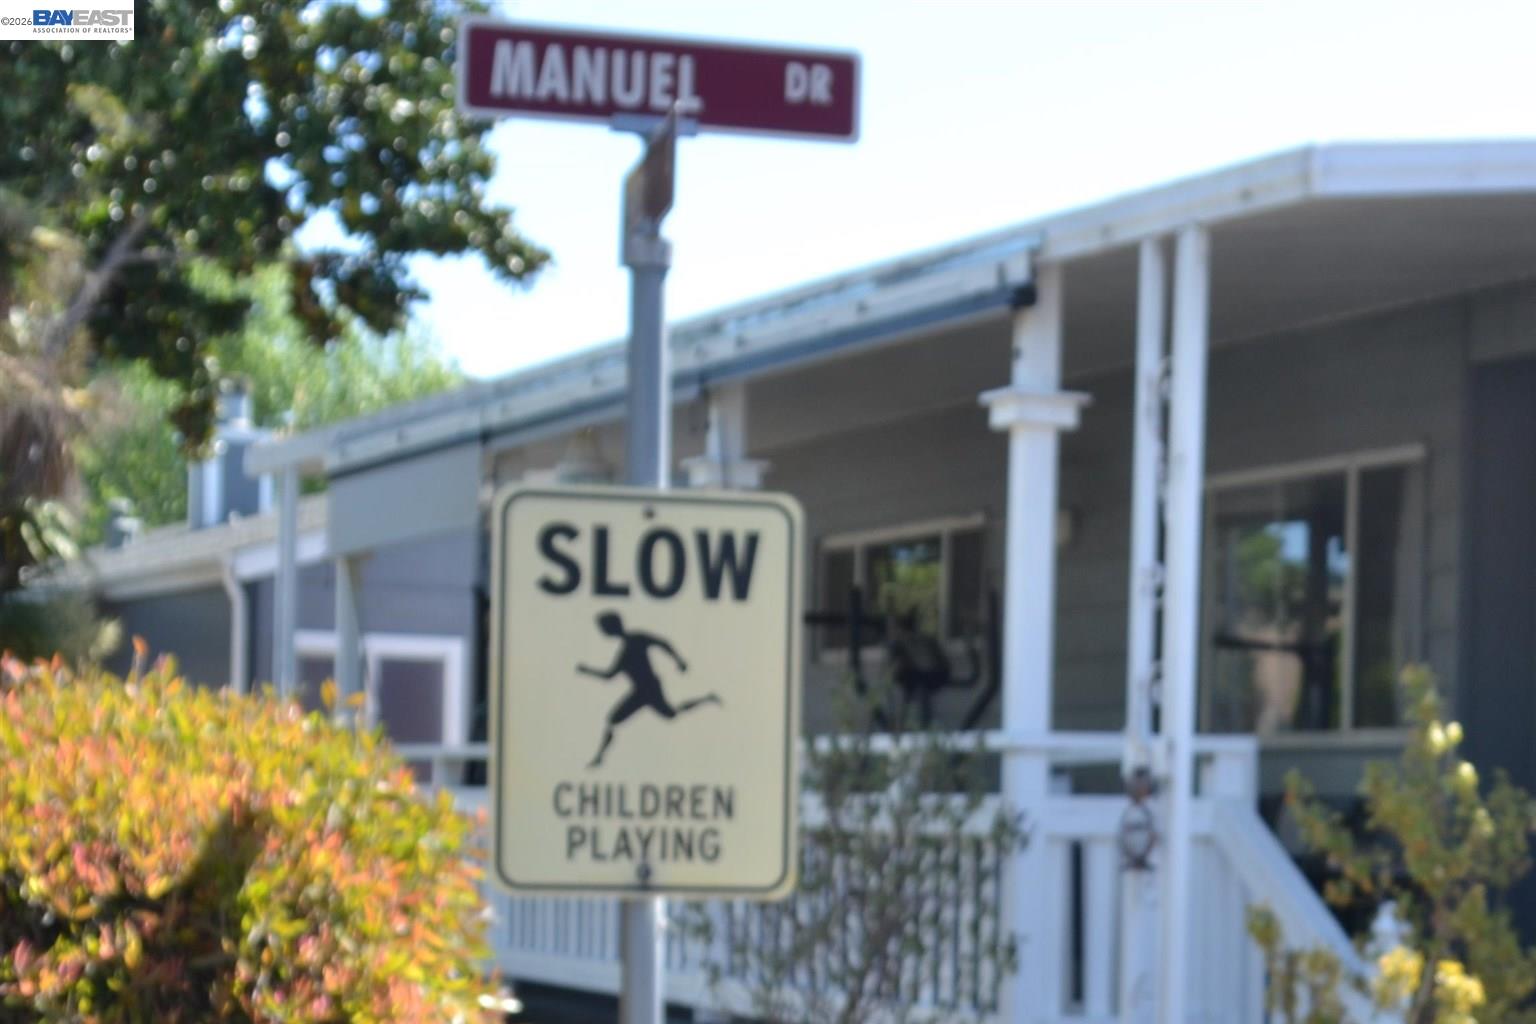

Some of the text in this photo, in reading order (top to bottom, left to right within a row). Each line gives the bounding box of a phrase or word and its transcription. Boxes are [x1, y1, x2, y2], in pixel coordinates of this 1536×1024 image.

[490, 38, 834, 114] MANUEL DR
[536, 521, 760, 601] SLOW
[552, 782, 735, 820] CHILDREN
[566, 825, 722, 863] PLAYING
